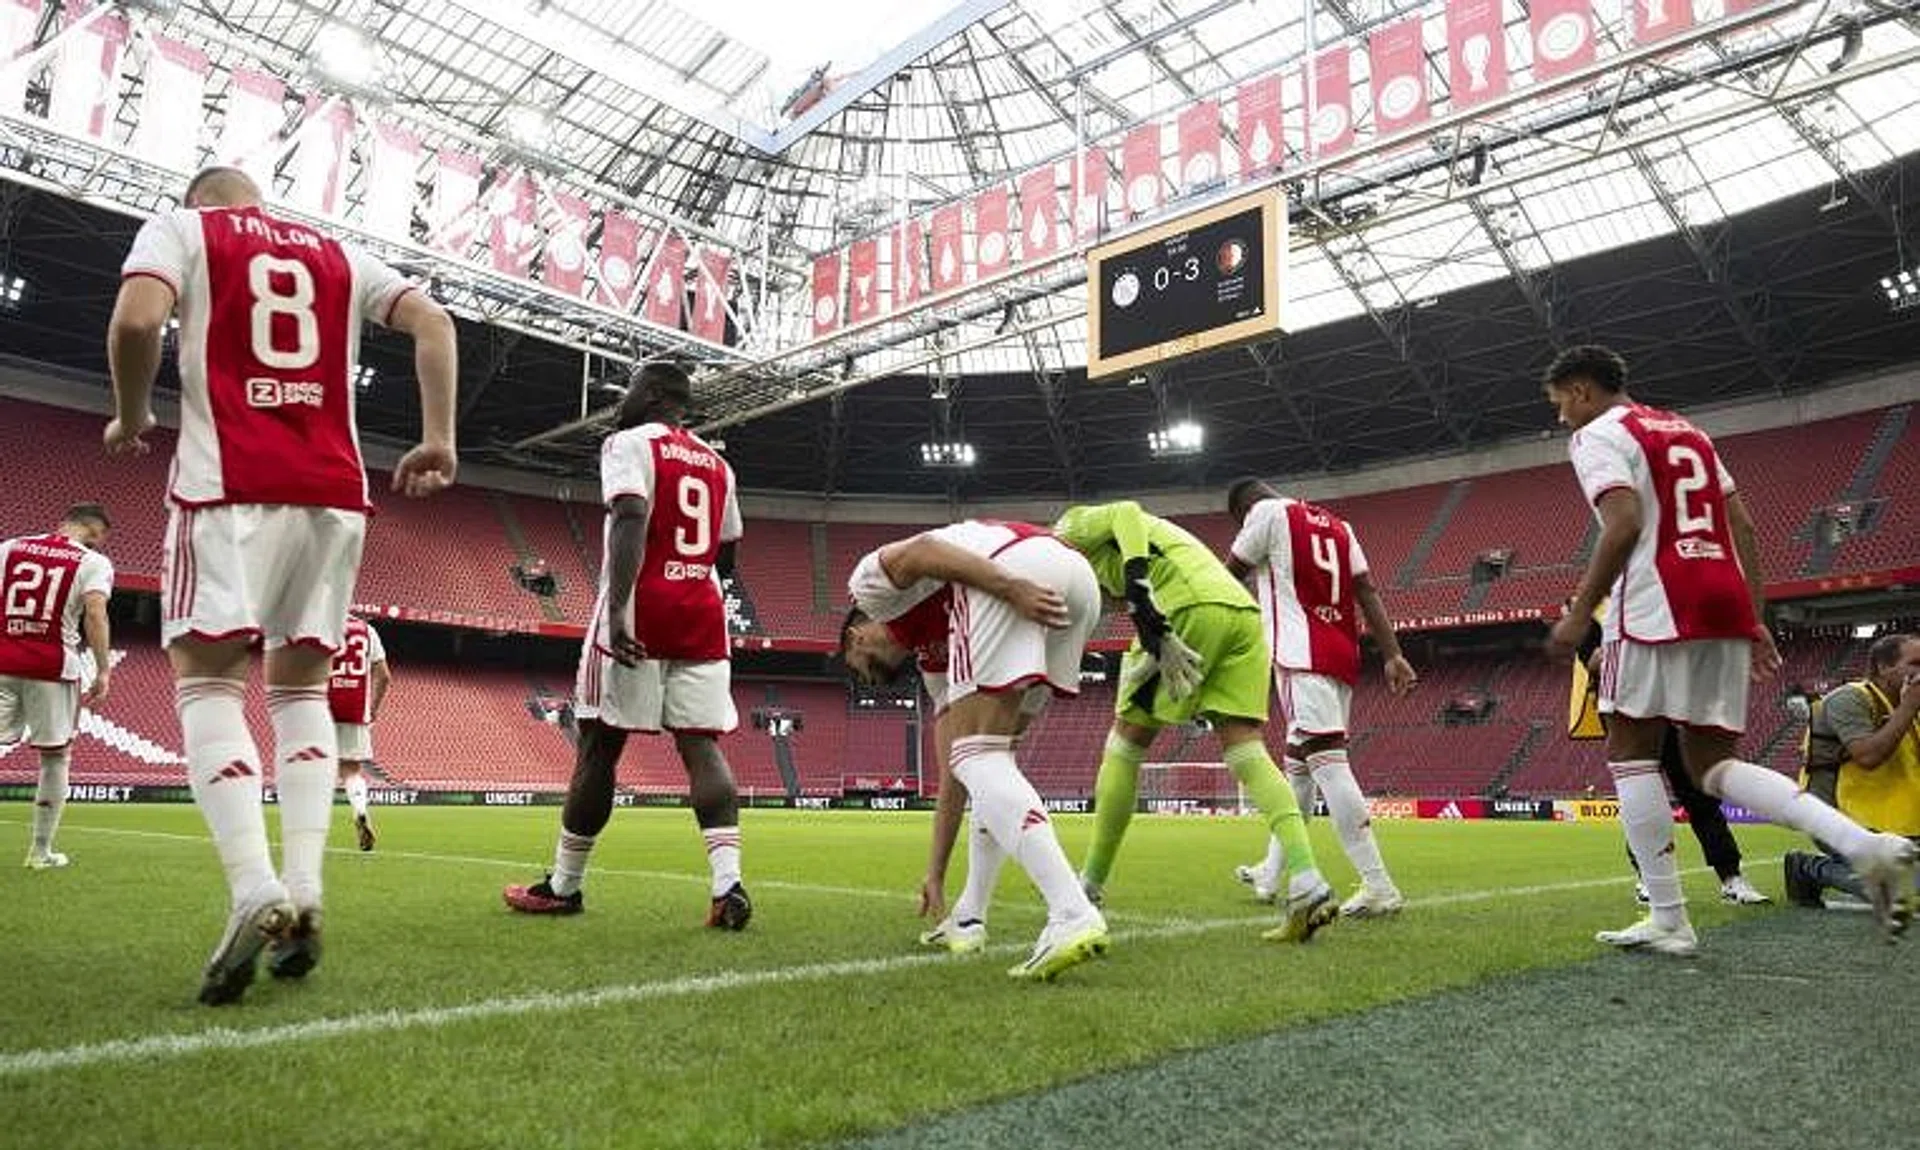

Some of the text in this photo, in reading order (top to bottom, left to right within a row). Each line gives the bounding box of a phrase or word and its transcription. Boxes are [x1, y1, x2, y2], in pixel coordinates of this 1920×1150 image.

[248, 253, 321, 369] 8
[675, 475, 710, 556] 9
[1667, 445, 1708, 533] 2
[5, 561, 66, 620] 21
[1310, 533, 1340, 605] 4
[330, 636, 368, 675] 23
[485, 792, 533, 805] UNIBET
